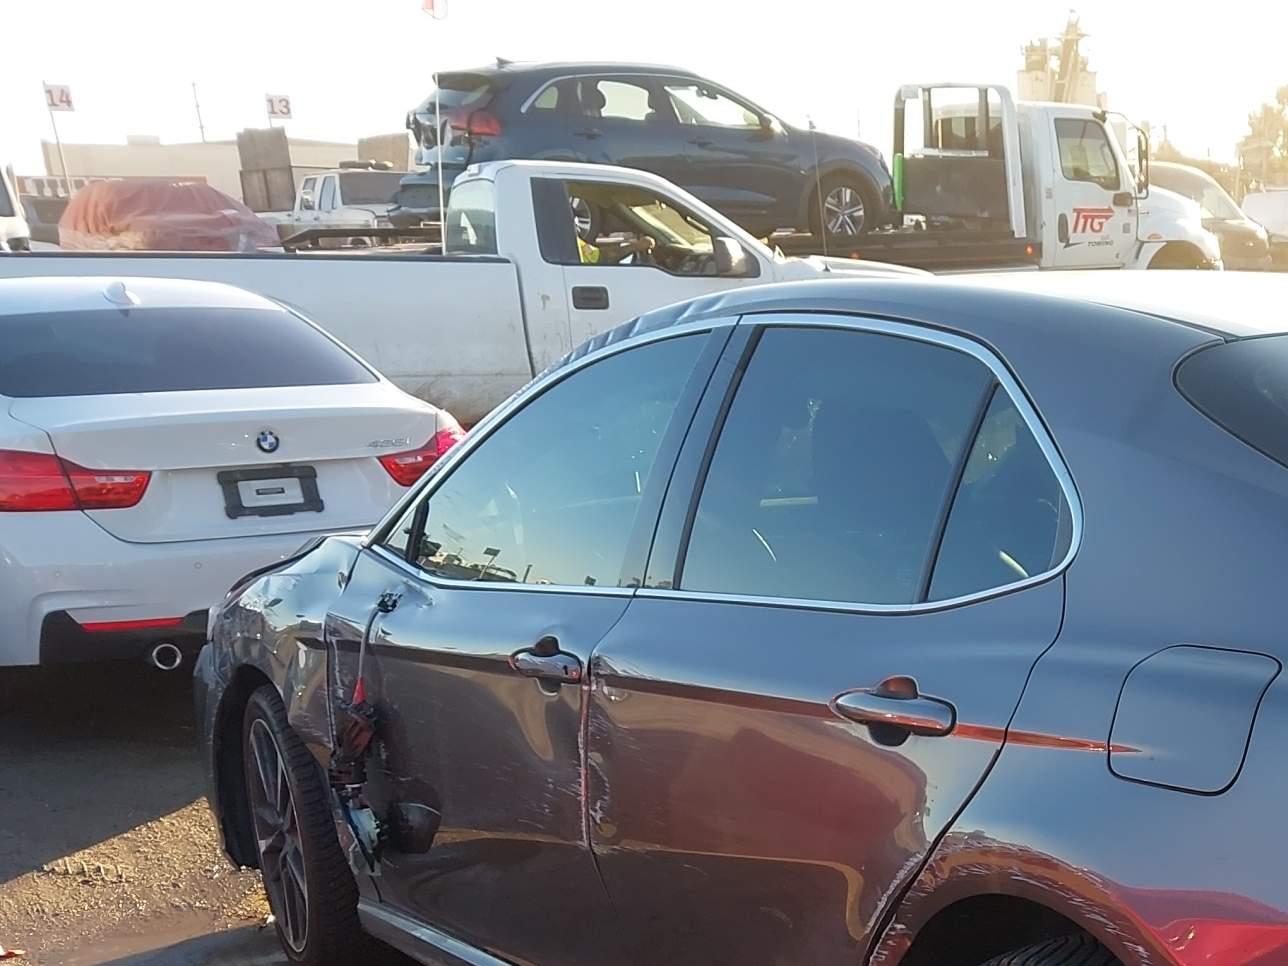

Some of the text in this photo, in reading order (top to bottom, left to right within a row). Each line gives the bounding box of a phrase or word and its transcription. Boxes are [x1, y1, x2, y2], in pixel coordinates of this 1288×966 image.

[47, 87, 72, 107] 14
[266, 98, 290, 115] 13
[1072, 208, 1115, 233] TTG
